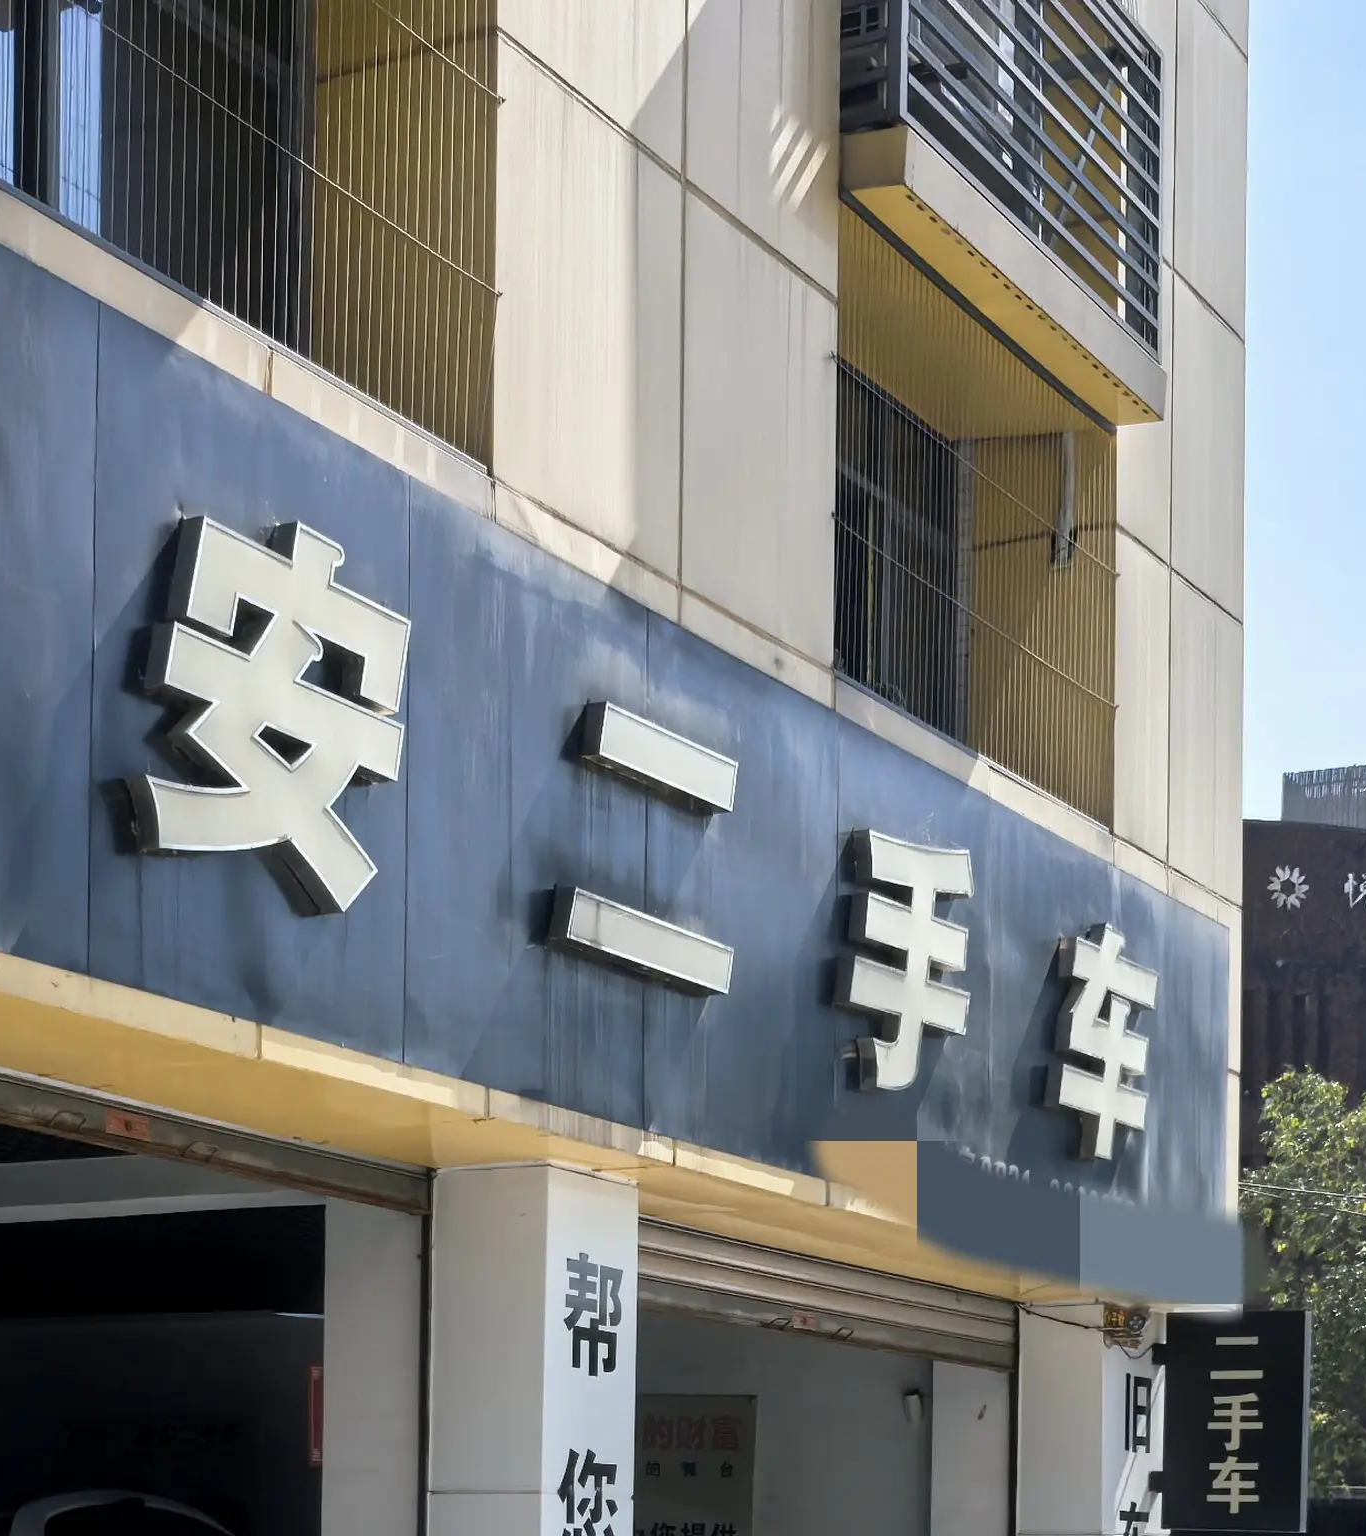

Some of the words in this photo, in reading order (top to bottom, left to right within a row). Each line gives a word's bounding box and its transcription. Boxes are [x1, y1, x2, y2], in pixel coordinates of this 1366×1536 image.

[641, 1414, 742, 1451] 的财富
[1206, 1336, 1264, 1514] 二手车
